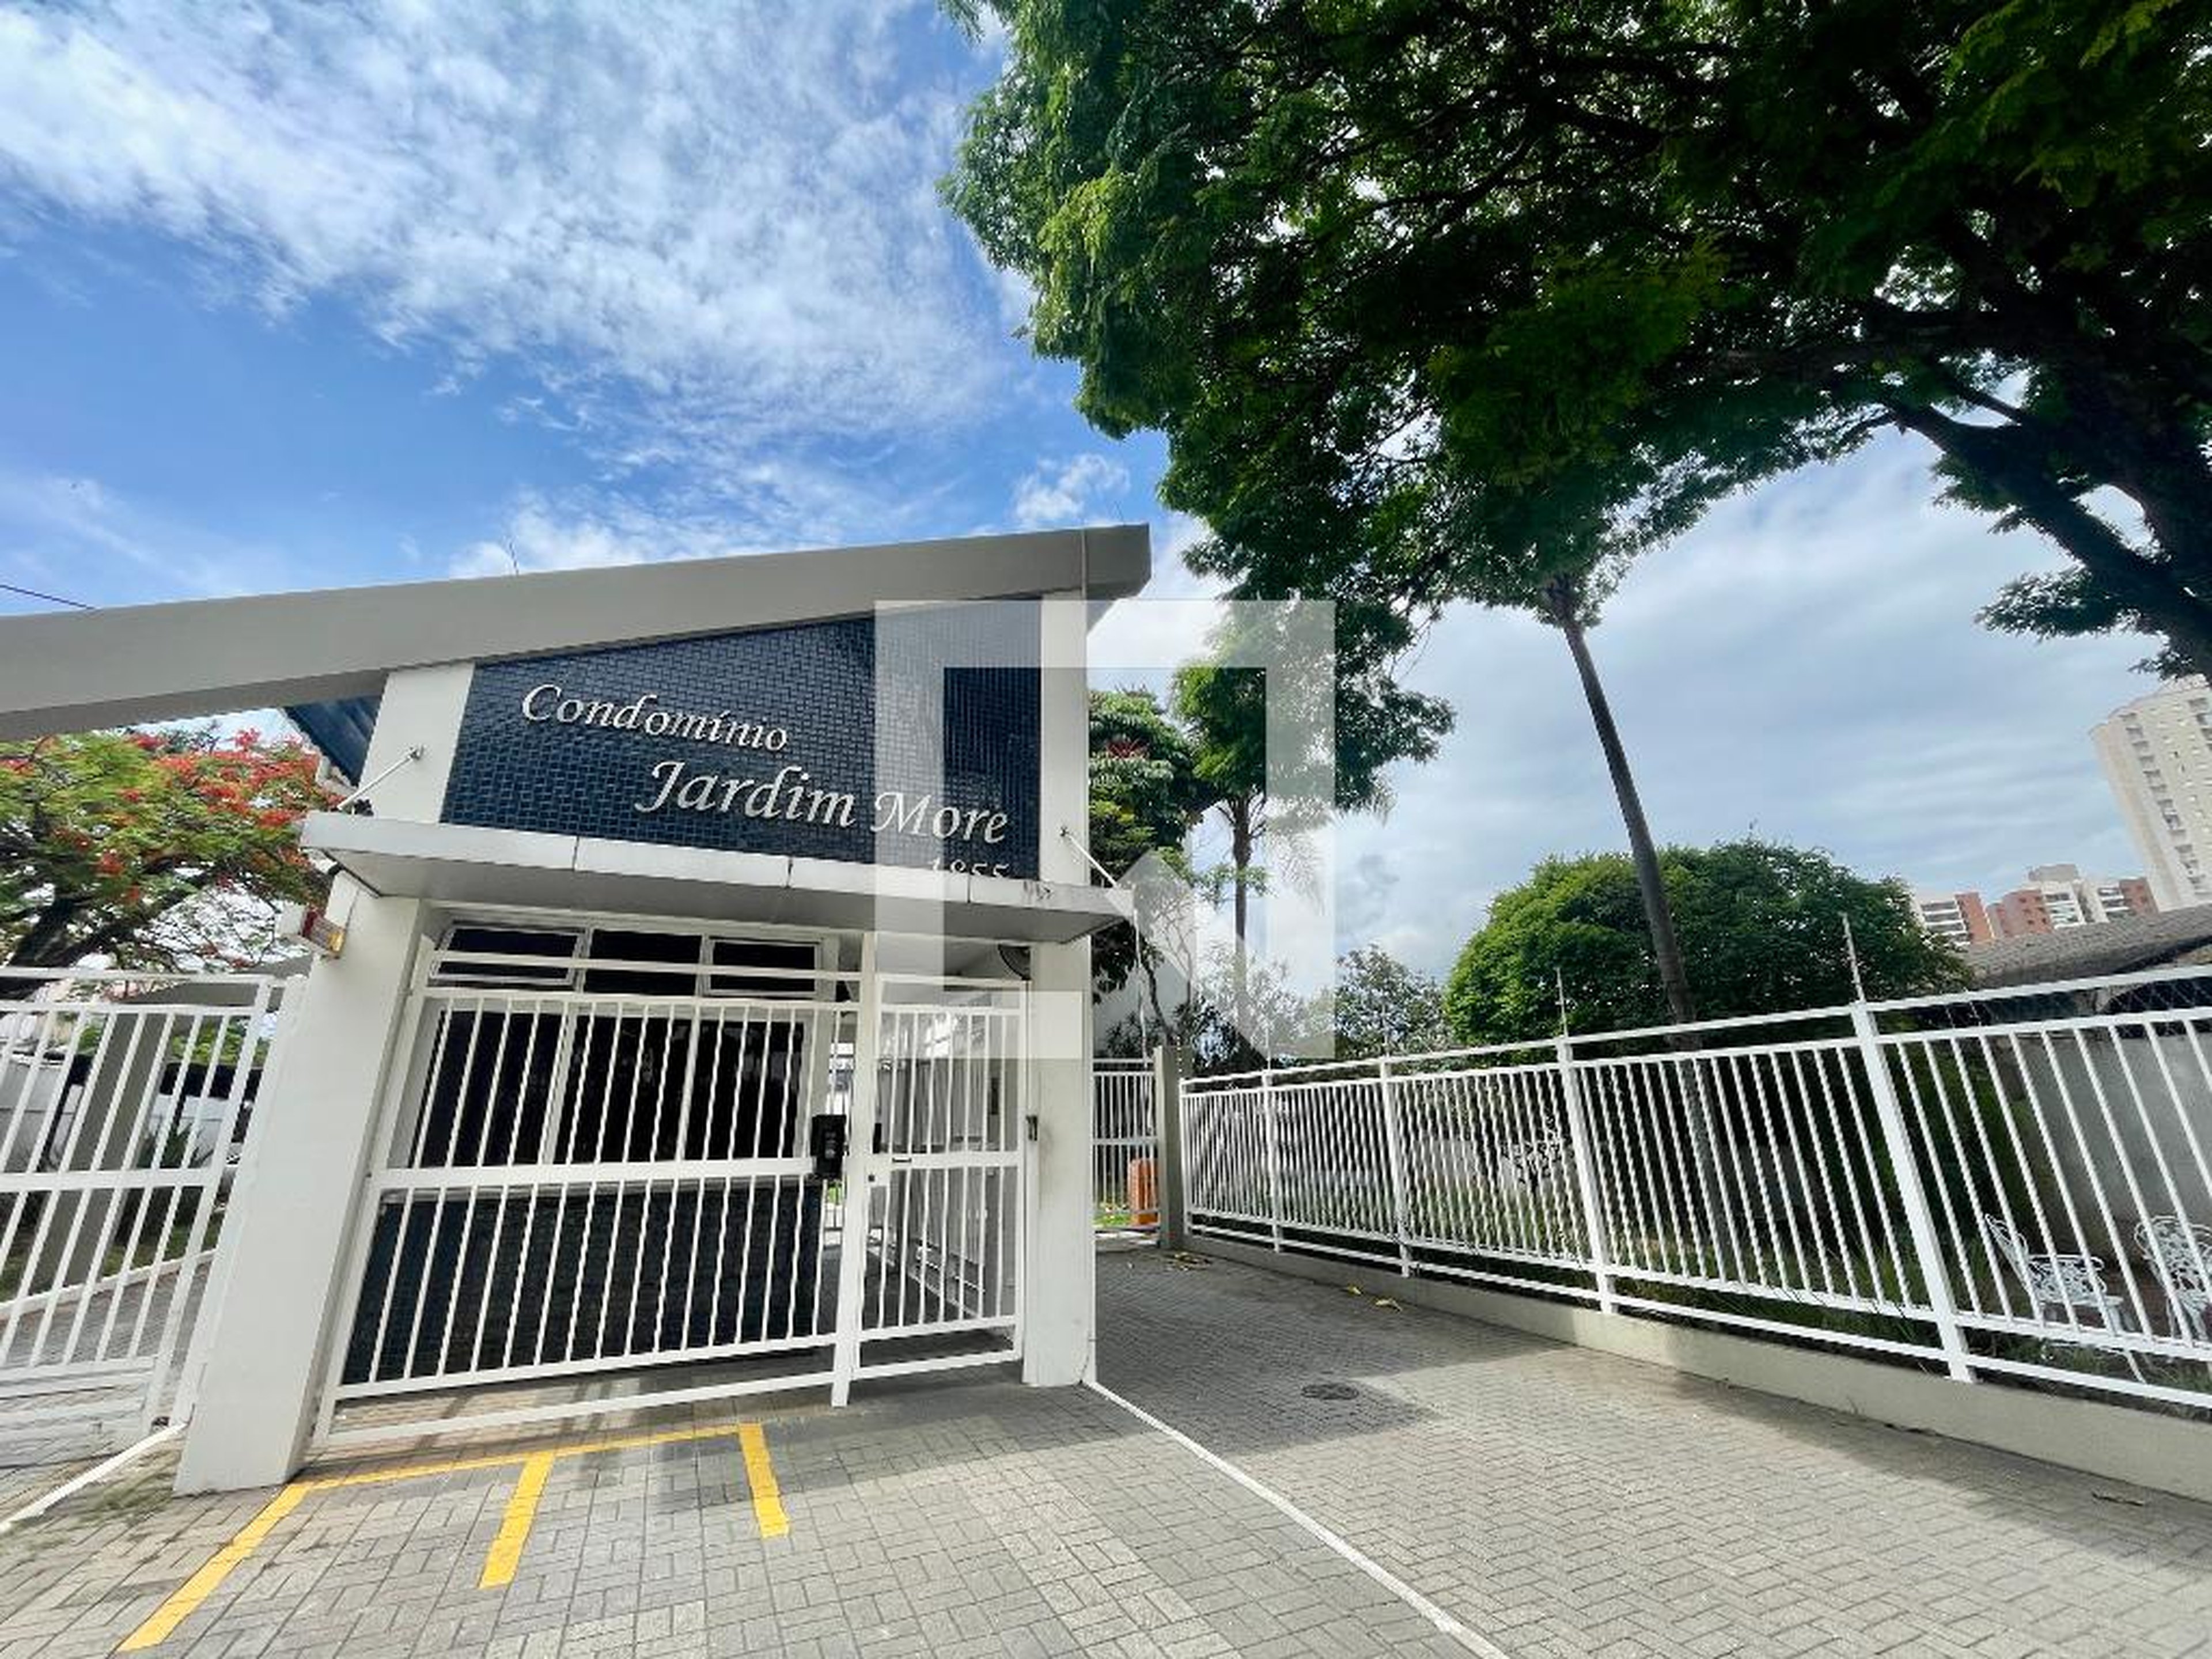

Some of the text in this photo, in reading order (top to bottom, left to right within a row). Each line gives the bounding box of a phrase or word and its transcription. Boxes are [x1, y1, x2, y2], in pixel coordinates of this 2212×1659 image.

[522, 684, 788, 751] Condomínio
[634, 761, 1008, 843] Jardim More
